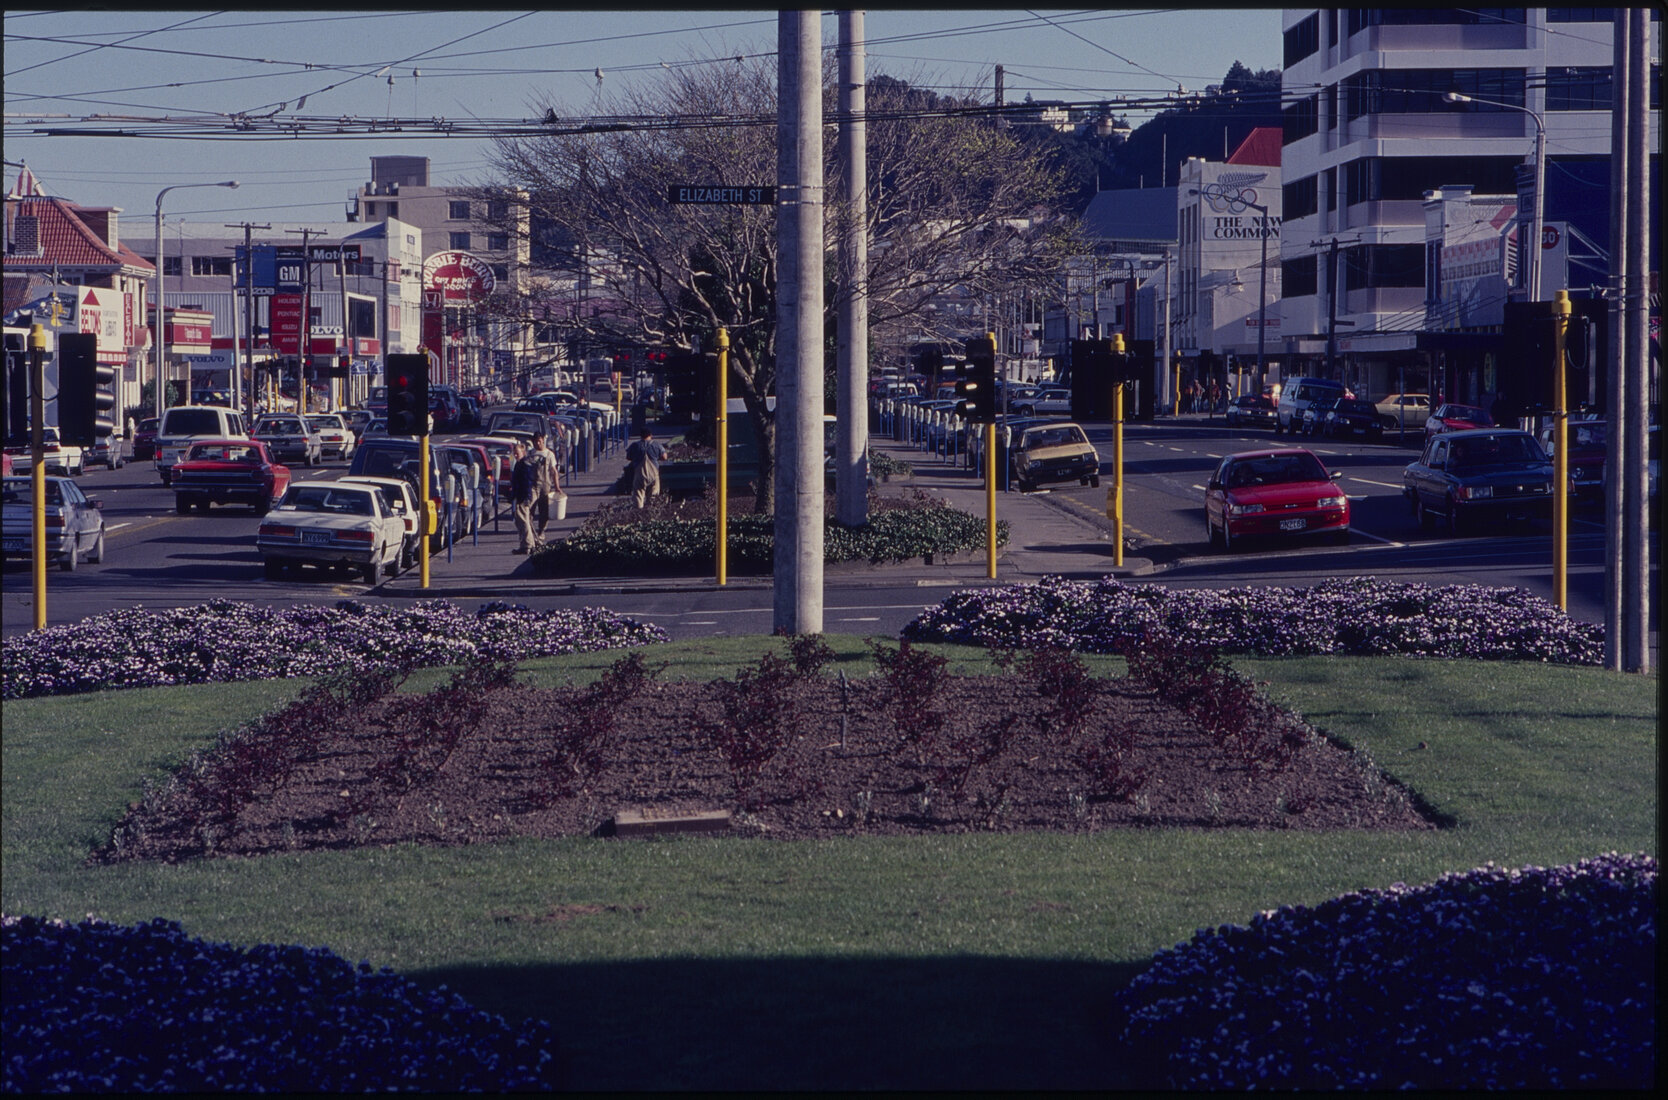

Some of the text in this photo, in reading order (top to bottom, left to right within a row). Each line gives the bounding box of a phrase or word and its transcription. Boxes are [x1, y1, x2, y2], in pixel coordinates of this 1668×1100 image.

[680, 188, 763, 202] ELIZABETH ST
[1213, 216, 1243, 227] THE
[279, 265, 300, 281] GM
[237, 287, 275, 295] mzda
